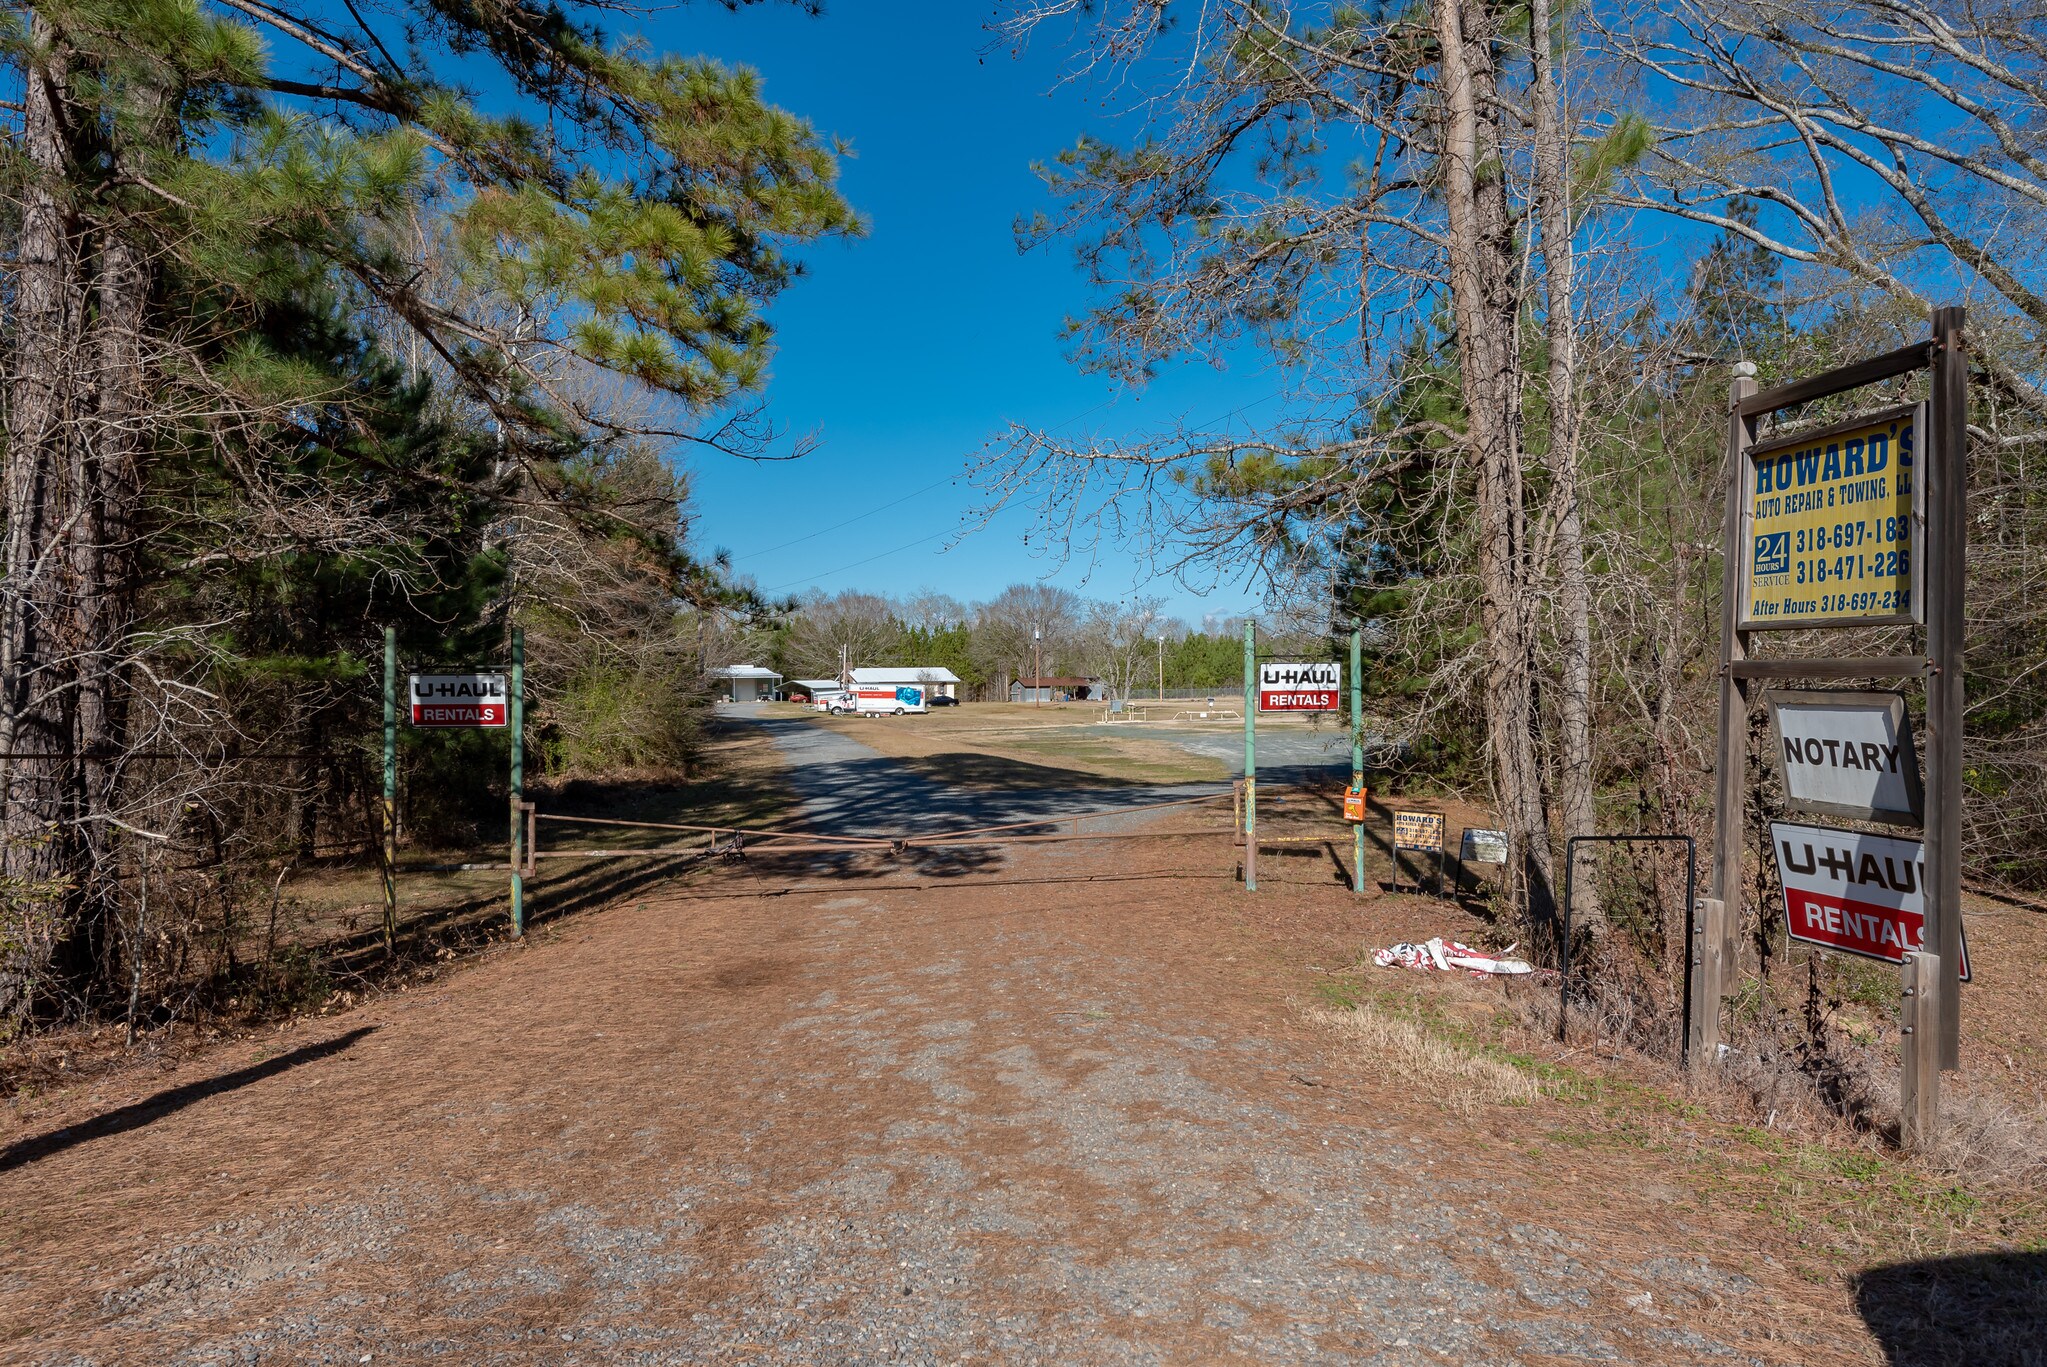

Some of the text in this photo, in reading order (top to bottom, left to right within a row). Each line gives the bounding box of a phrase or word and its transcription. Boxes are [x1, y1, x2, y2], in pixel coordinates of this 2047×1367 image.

[1756, 423, 1913, 495] HOWARD'S
[1756, 473, 1911, 519] AUTO REPAIR & TOWING, LL
[1796, 515, 1908, 552] 318-697-183
[1757, 534, 1787, 568] 24
[1755, 562, 1779, 572] HOURS
[1796, 549, 1909, 584] 318-471-226
[1753, 575, 1790, 587] SERVICE
[1753, 590, 1911, 615] After Hours 318-697-234
[1264, 670, 1336, 684] U-HAUL
[415, 683, 501, 697] U-HAUL
[1269, 694, 1329, 706] RENTALS
[423, 708, 495, 721] RENTALS
[1783, 737, 1900, 774] NOTARY
[1397, 814, 1442, 824] HOWARD'S
[1781, 841, 1924, 894] U-HAU
